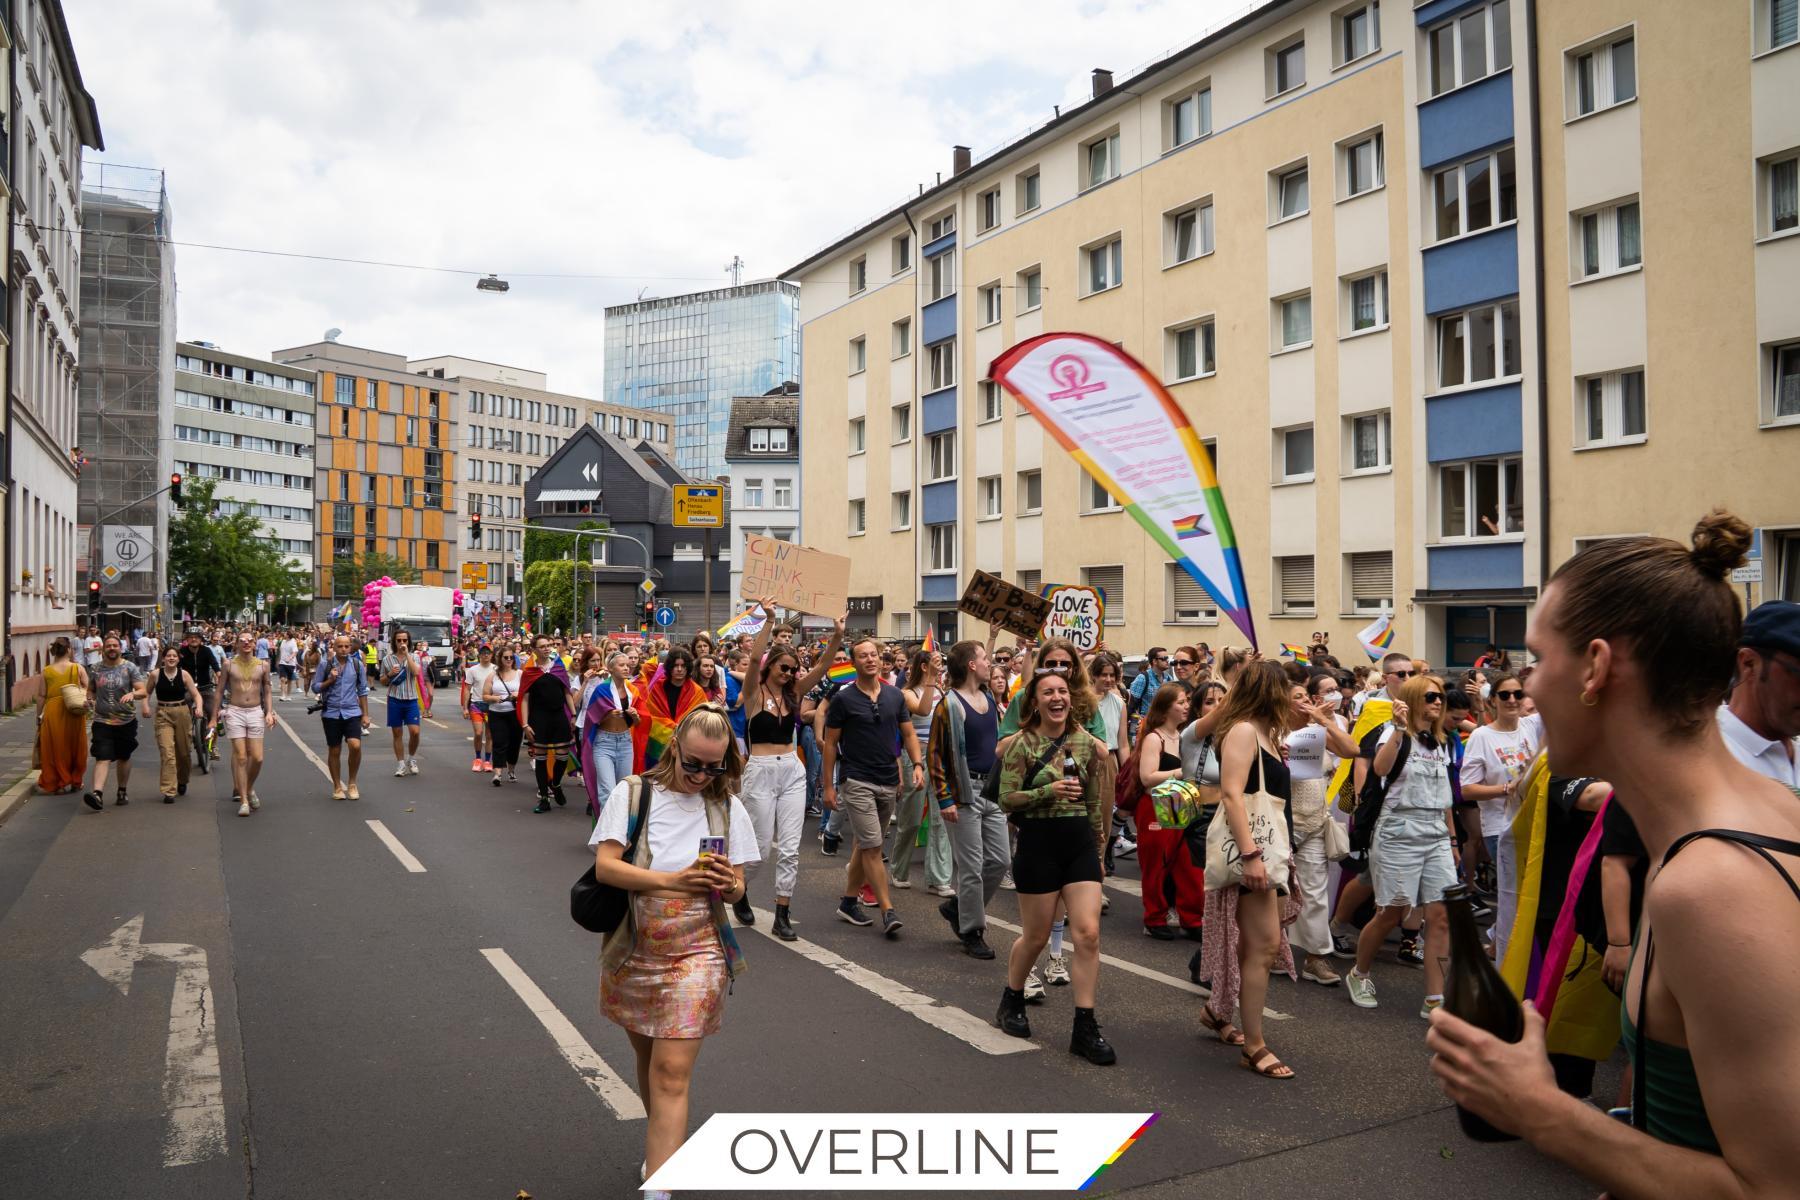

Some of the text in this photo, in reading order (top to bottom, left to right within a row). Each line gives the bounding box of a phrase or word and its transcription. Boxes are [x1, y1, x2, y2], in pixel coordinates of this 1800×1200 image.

[751, 558, 803, 587] THINK
[742, 575, 825, 609] STRAIGHT
[972, 575, 1048, 624] My Body
[1055, 595, 1093, 614] LOVE
[961, 596, 1037, 637] my Choice
[1051, 612, 1093, 630] ALWAYS
[1253, 828, 1274, 845] ood
